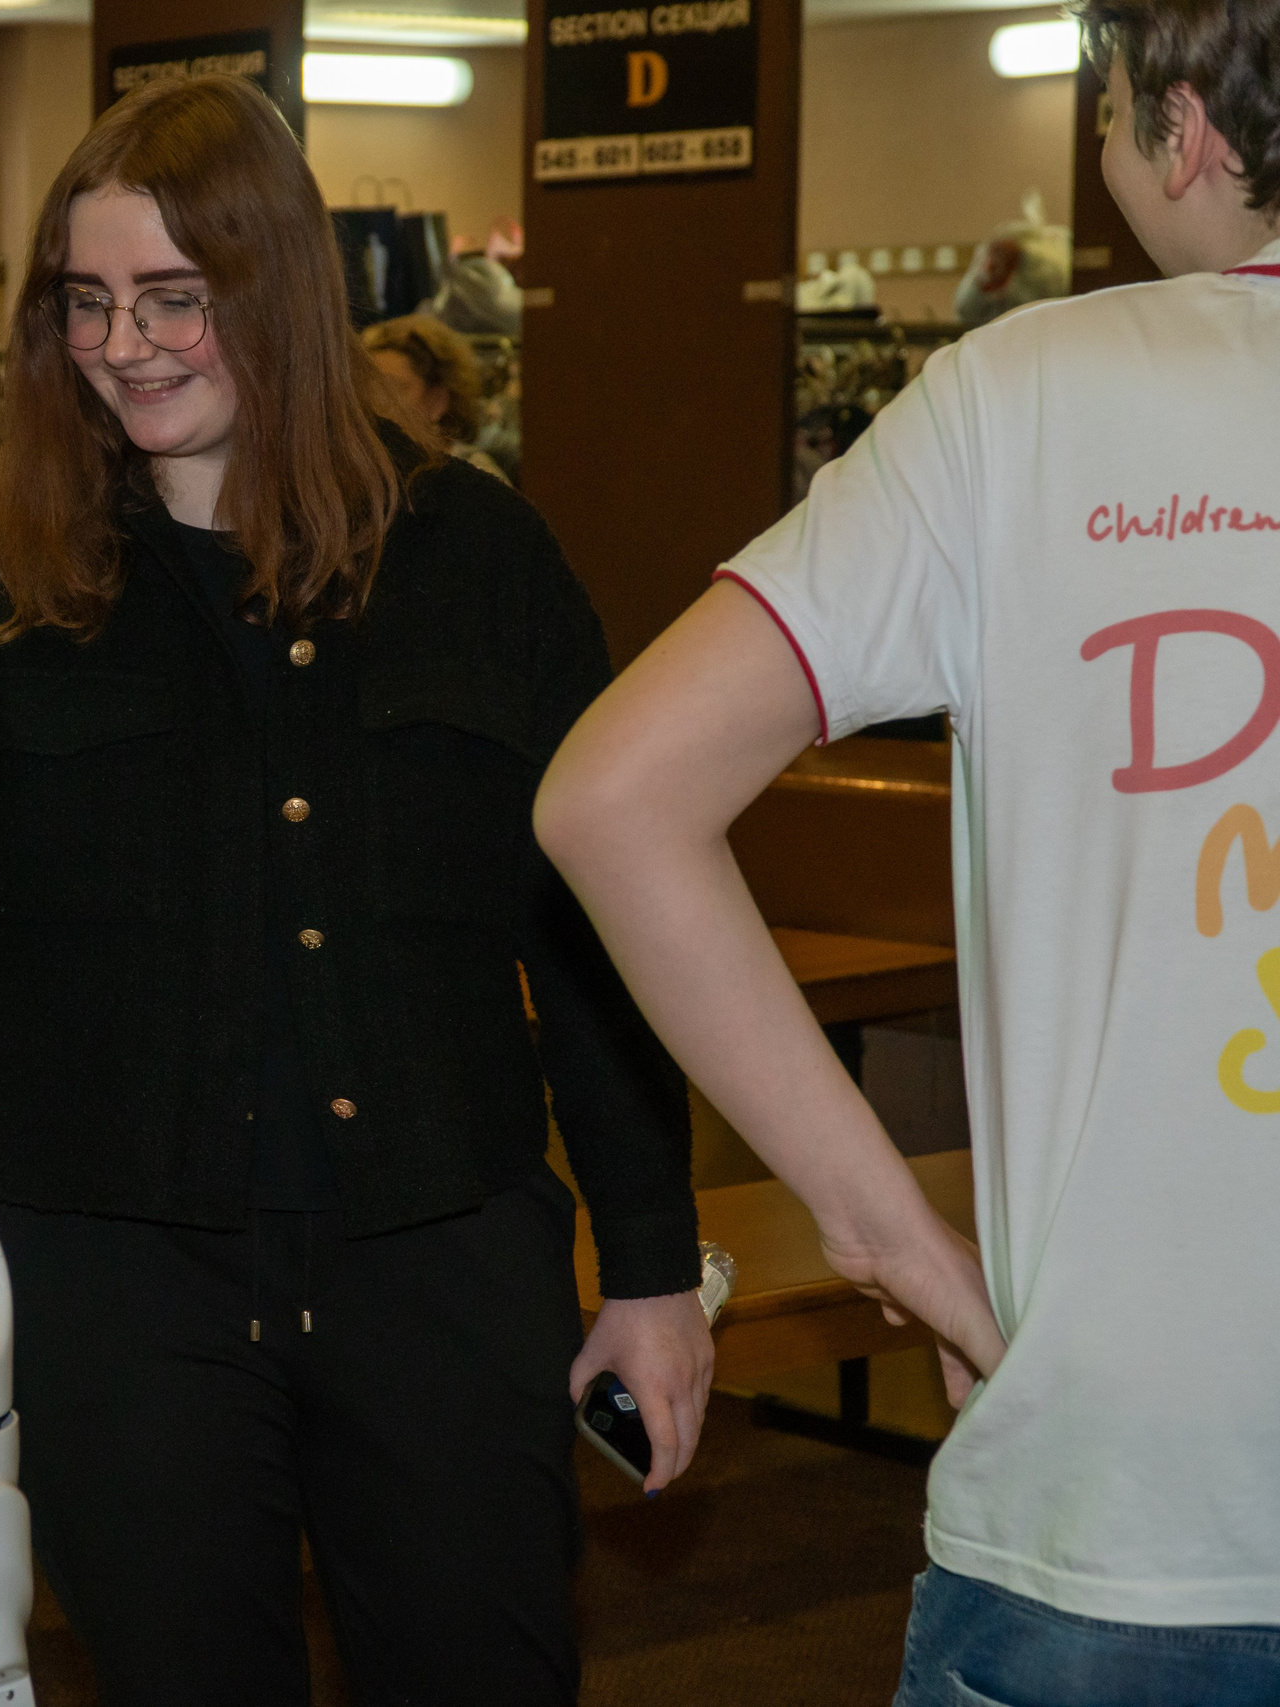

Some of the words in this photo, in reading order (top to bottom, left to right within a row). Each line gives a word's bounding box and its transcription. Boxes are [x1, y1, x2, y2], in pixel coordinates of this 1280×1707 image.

[550, 8, 648, 47] SECTION
[626, 51, 669, 108] D
[1086, 494, 1280, 543] Children
